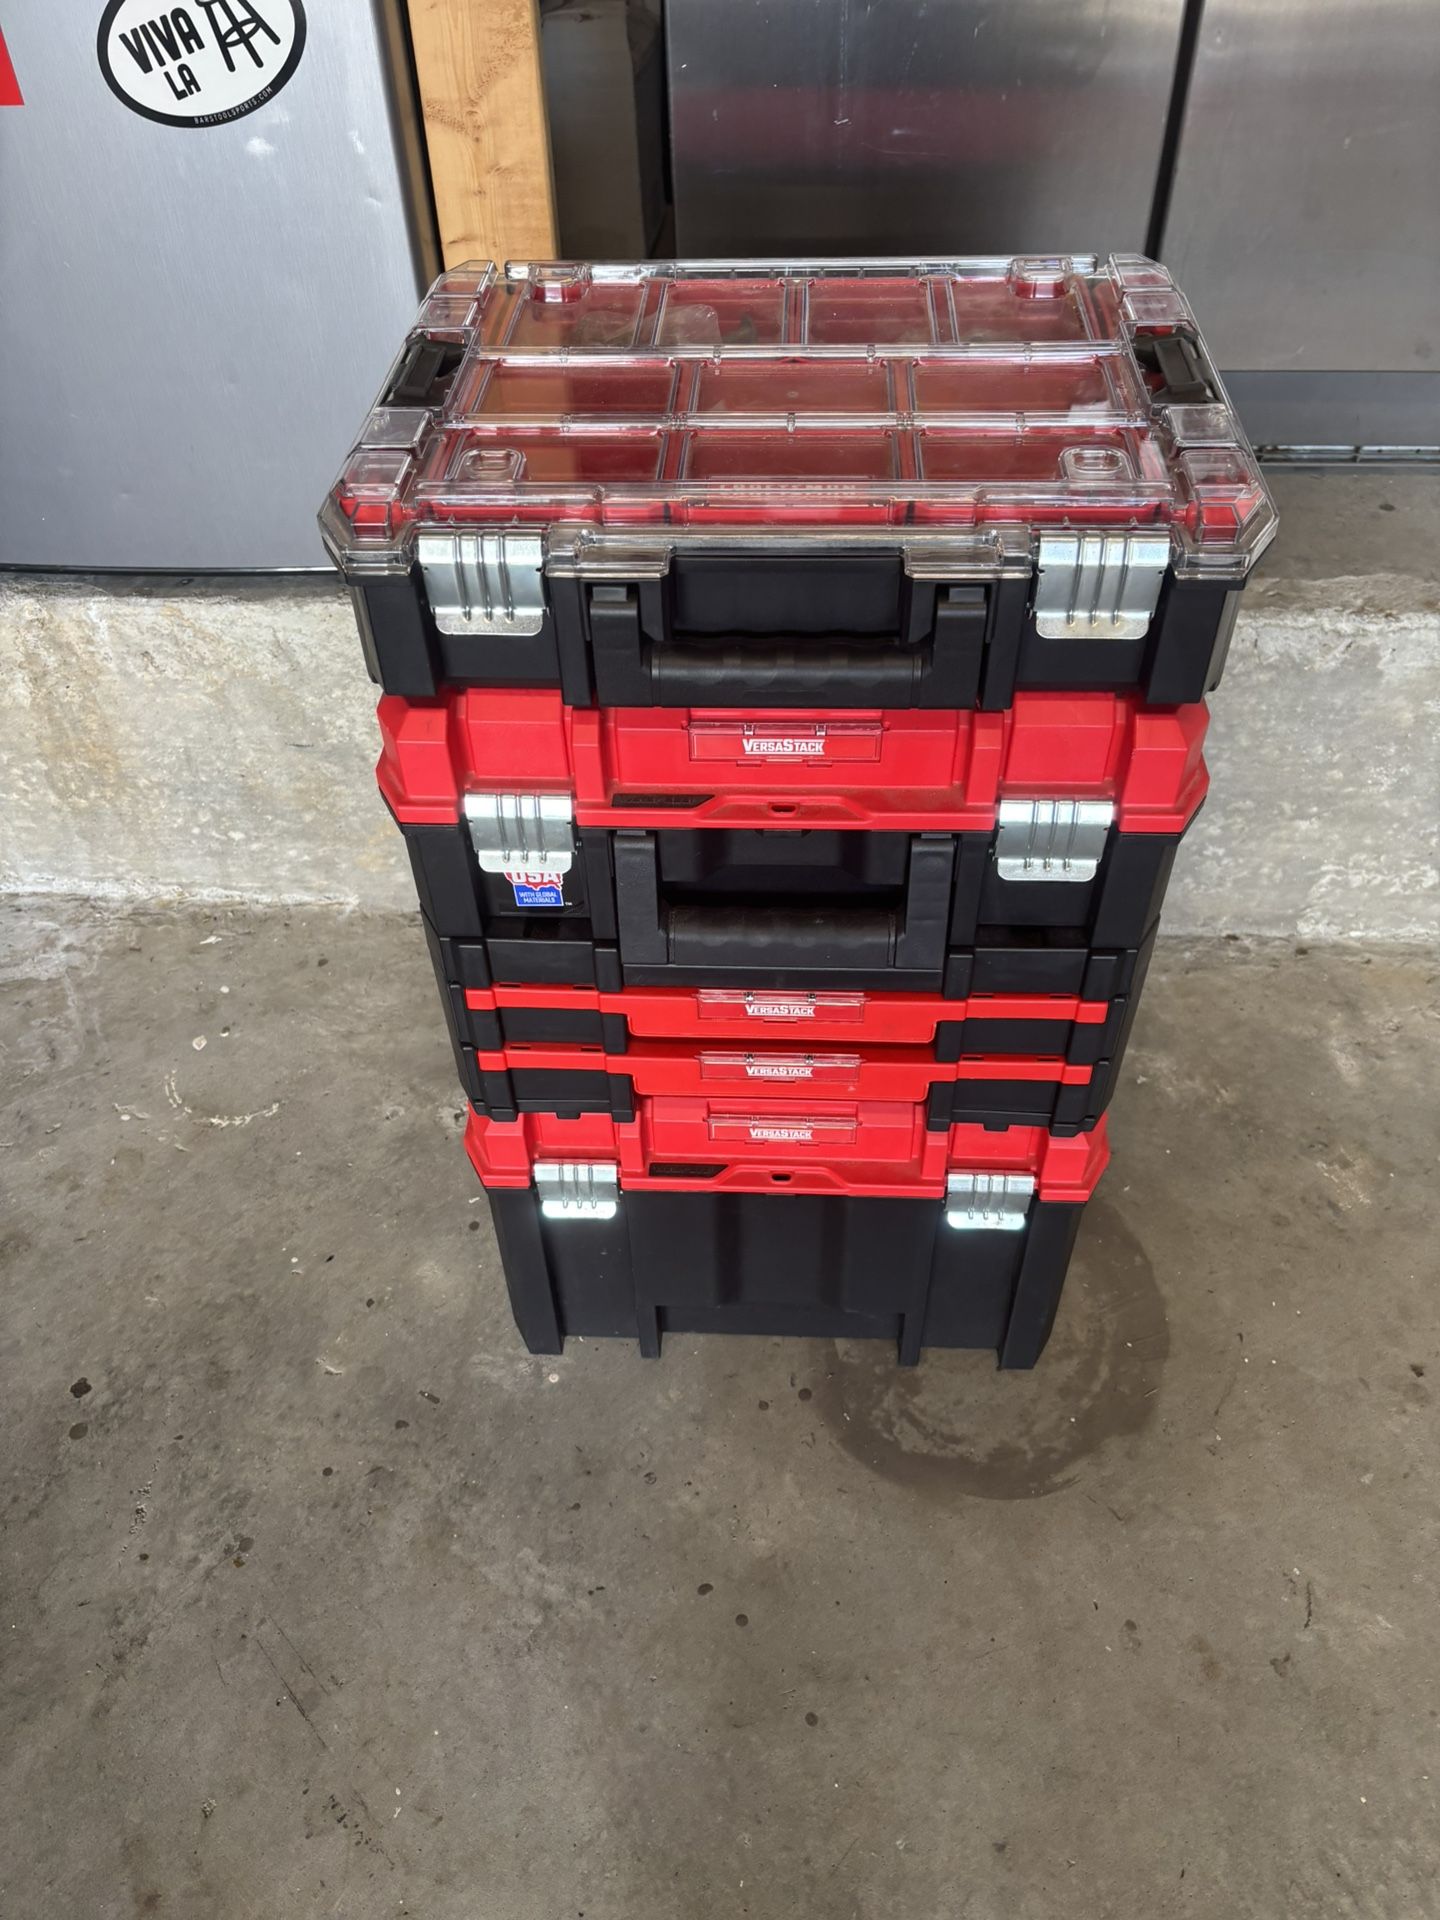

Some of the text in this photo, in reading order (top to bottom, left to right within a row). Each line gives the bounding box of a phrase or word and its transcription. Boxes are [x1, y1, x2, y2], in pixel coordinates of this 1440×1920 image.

[118, 7, 205, 74] VIVA
[163, 63, 201, 100] LA
[193, 86, 273, 125] BARSTOOLSPORTS.COM
